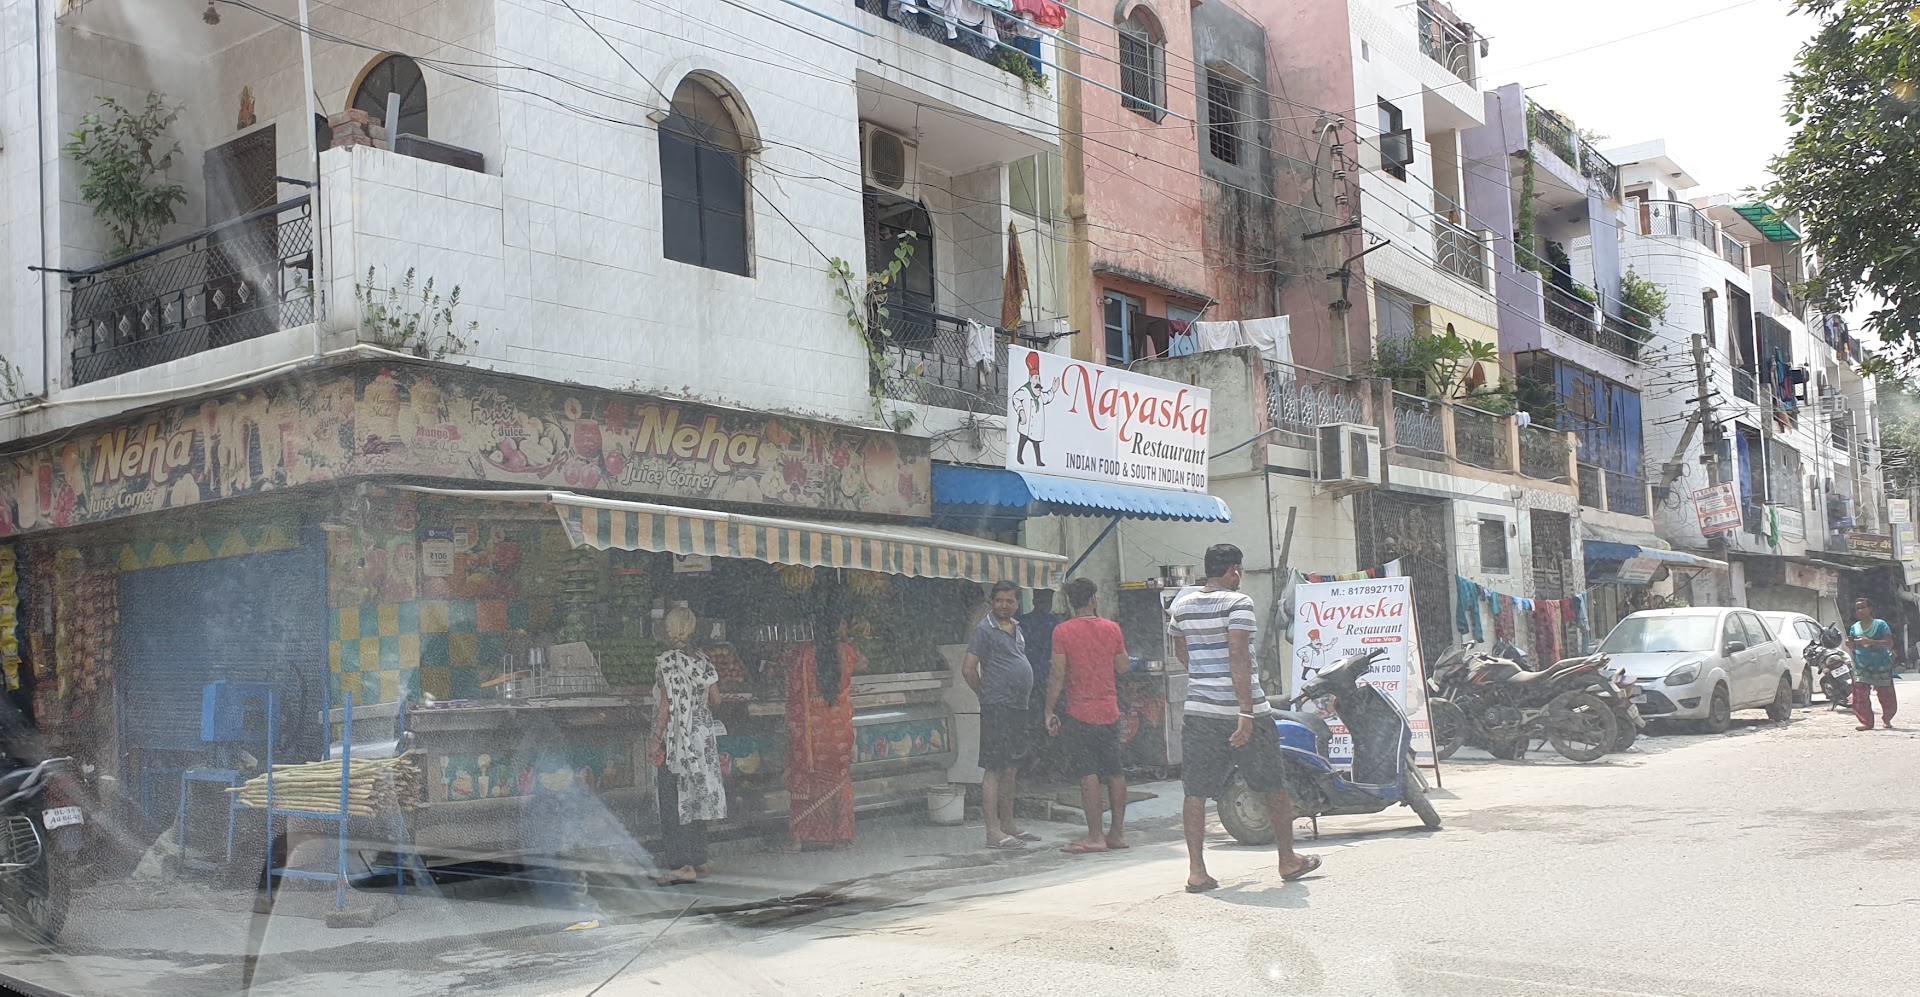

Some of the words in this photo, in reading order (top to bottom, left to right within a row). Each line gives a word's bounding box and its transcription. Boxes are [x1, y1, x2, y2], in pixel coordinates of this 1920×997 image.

[1062, 363, 1208, 442] Nayaska
[416, 425, 449, 440] Mango
[634, 404, 760, 475] Neha
[1131, 432, 1205, 465] Restaurant
[94, 422, 195, 486] Neha
[1066, 452, 1097, 472] INDIAN
[1099, 458, 1120, 476] FOOD
[1122, 462, 1129, 477] &
[1131, 463, 1156, 482] SOUTH
[1158, 467, 1185, 486] INDIAN
[1186, 472, 1205, 488] FOOD
[622, 461, 663, 486] Juice
[666, 466, 718, 492] Corner
[86, 494, 115, 519] Juice
[118, 487, 157, 509] Corner
[1348, 584, 1405, 596] 8178927170
[1299, 597, 1404, 630] Nayaska
[1345, 623, 1403, 636] Restaurant
[1381, 665, 1401, 674] FOOD
[1327, 736, 1348, 745] OME
